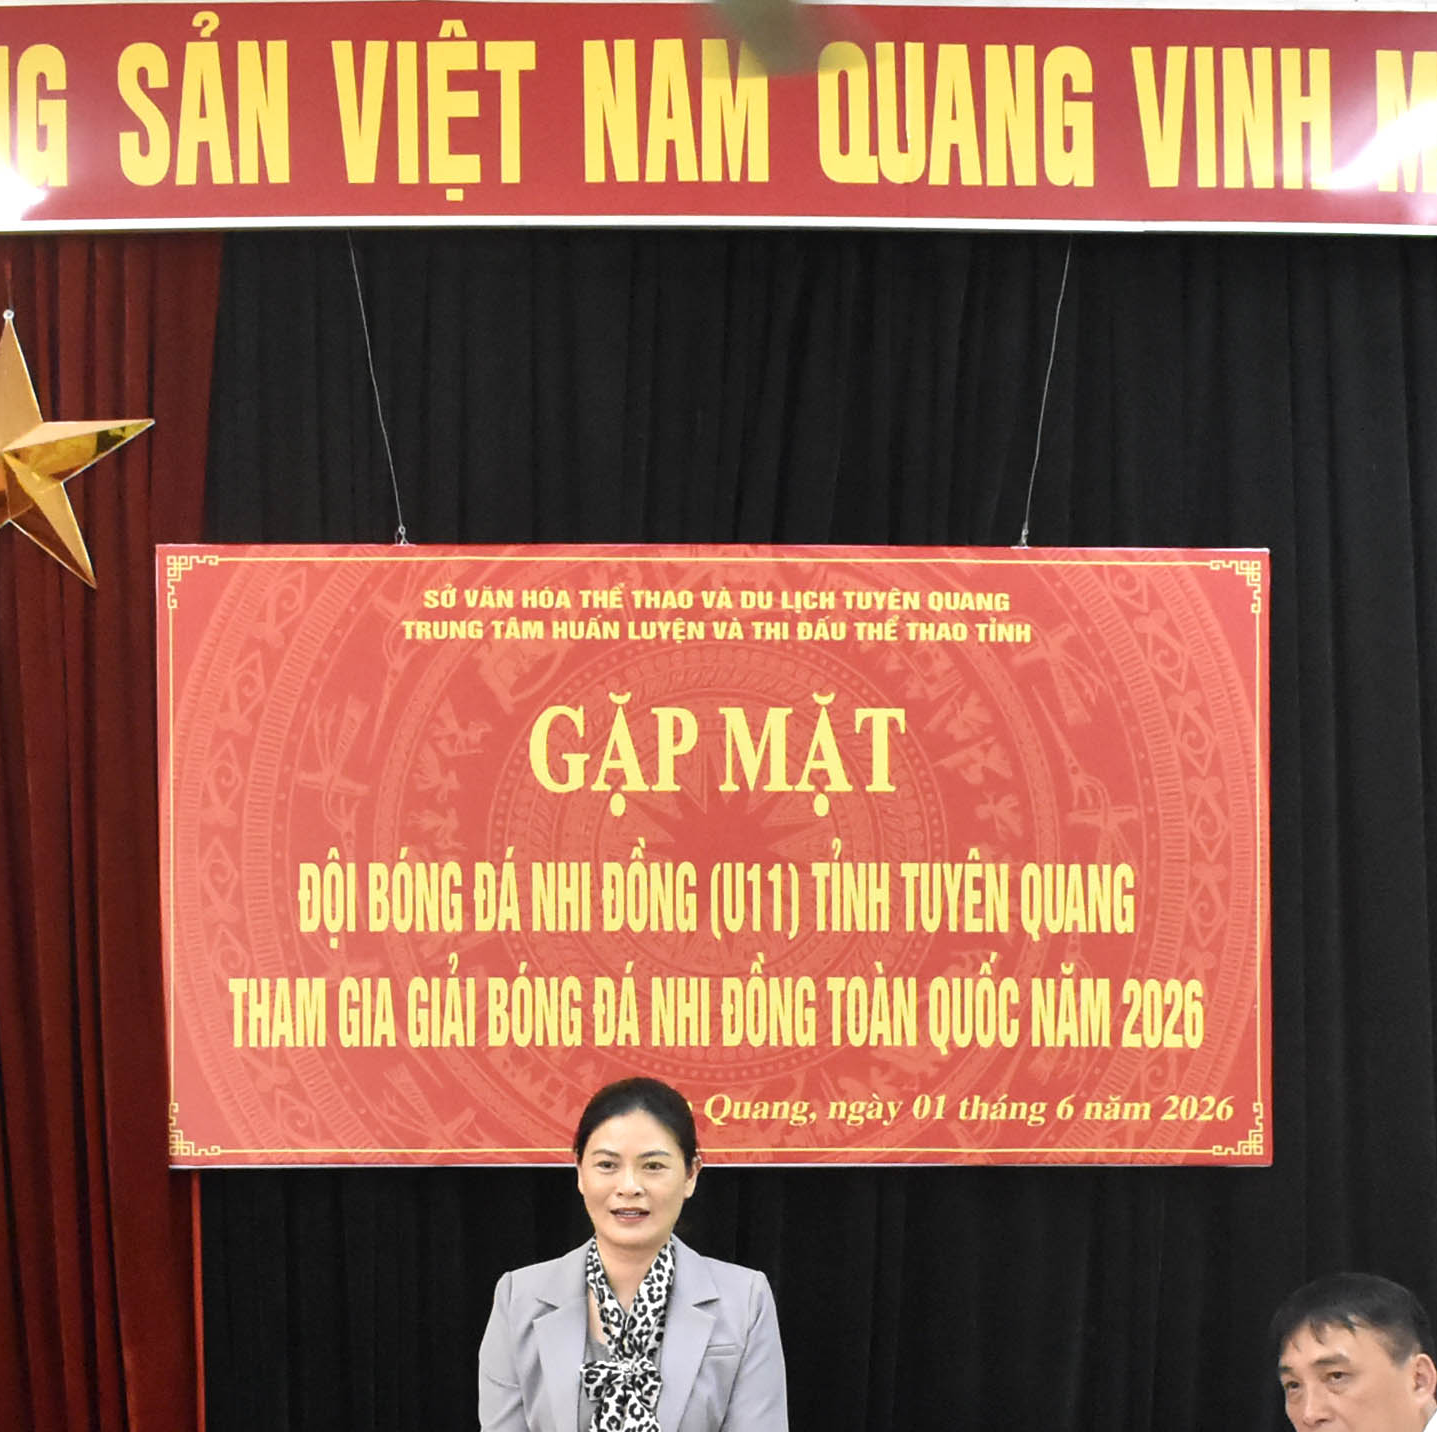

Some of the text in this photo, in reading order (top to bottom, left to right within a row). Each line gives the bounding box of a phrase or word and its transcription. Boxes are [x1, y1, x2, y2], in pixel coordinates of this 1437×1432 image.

[118, 11, 291, 187] SẢN
[332, 19, 535, 201] VIỆT
[584, 38, 770, 183] NAM
[818, 41, 1094, 187] QUANG
[1131, 46, 1333, 190] VINH
[402, 614, 1032, 644] TRUNG TÂM HUẤN LUYỆN VÀ THI ĐẤU THỂ THAO TỈNH
[423, 583, 1011, 614] SỞ VĂN HÓA THỂ THAO VÀ DU LỊCH TUYÊN QUANG
[529, 691, 906, 817] GẶP MẶT
[298, 837, 1135, 949] ĐỘI BÓNG ĐÁ NHI ĐỒNG (U11) TỈNH TUYÊN QUANG
[229, 952, 1205, 1057] THAM GIA GIẢI BÓNG ĐÁ NHI ĐỒNG TOÀN QUỐC NĂM 2026
[703, 1093, 1234, 1127] Quang, ngày 01 tháng 6 năm 2026
